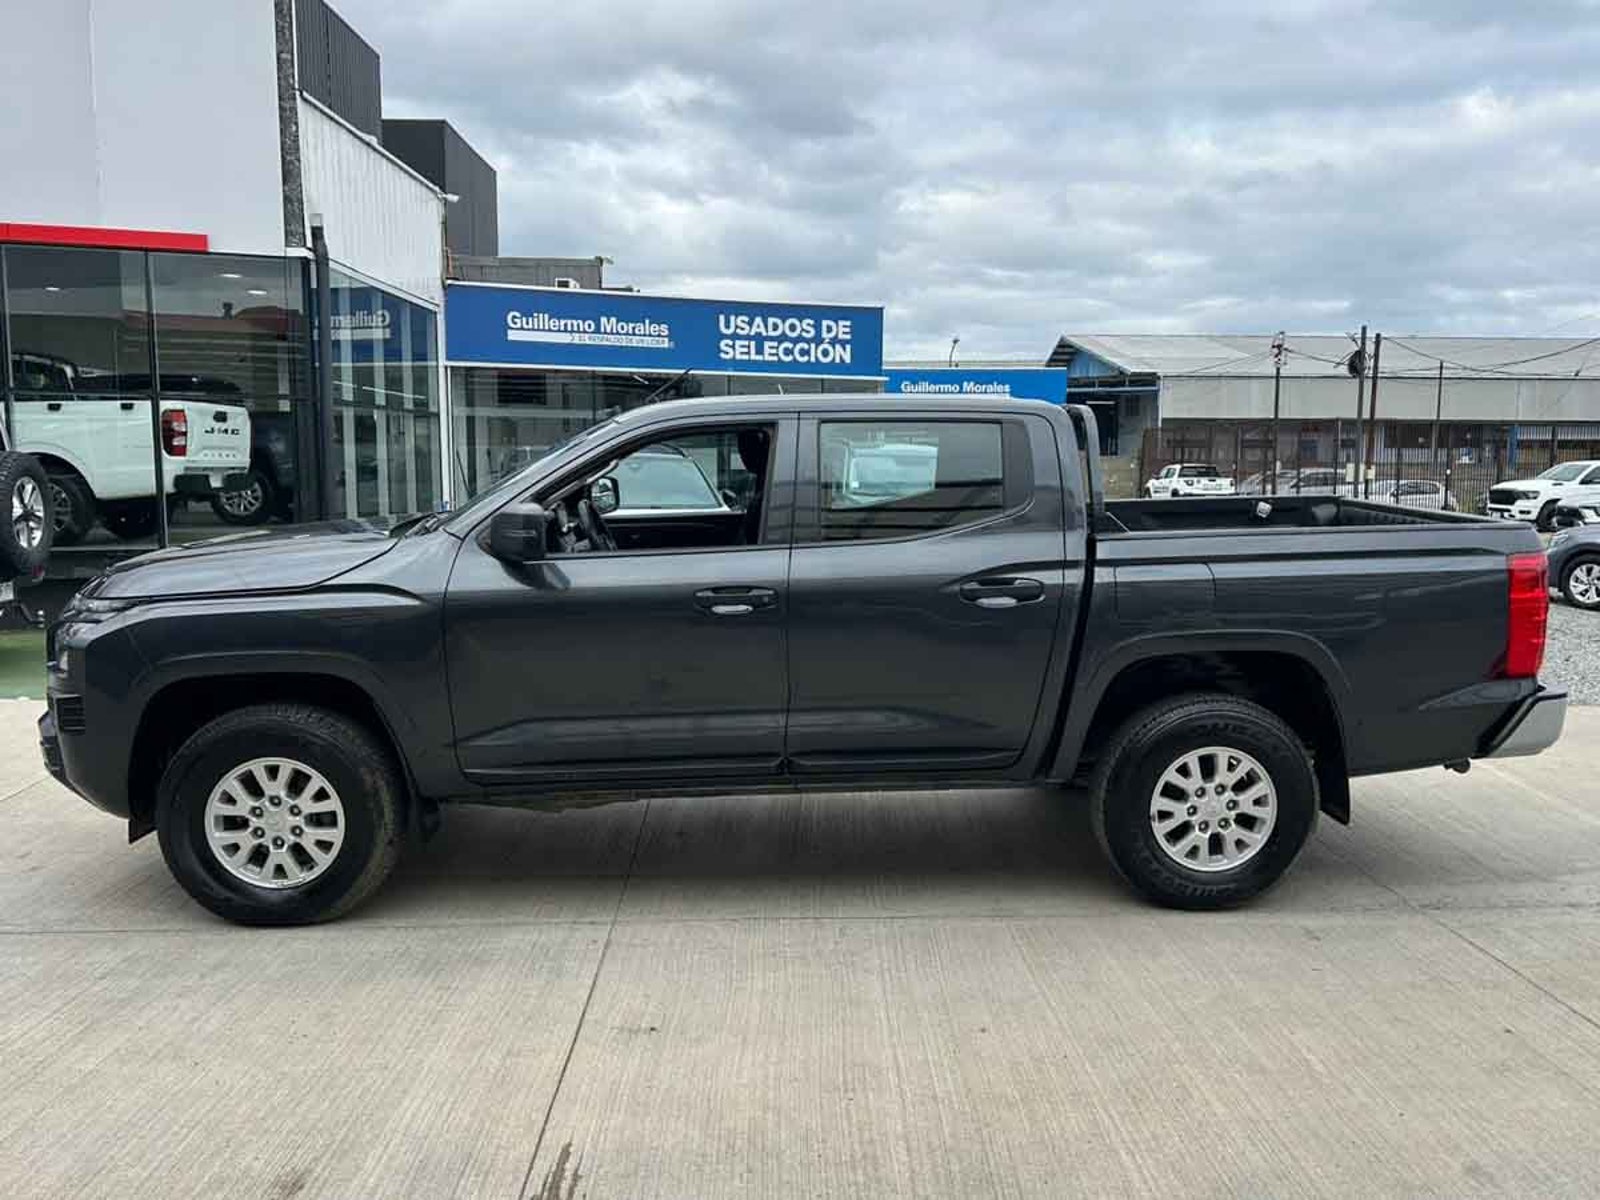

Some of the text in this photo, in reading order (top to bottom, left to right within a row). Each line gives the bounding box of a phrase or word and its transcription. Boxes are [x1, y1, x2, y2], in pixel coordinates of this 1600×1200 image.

[507, 311, 669, 336] Guillermo Morales
[718, 314, 852, 340] USADOS DE
[719, 338, 852, 363] SELECCIÓN
[900, 381, 1011, 393] Guillermo Morales
[204, 427, 240, 436] JMC
